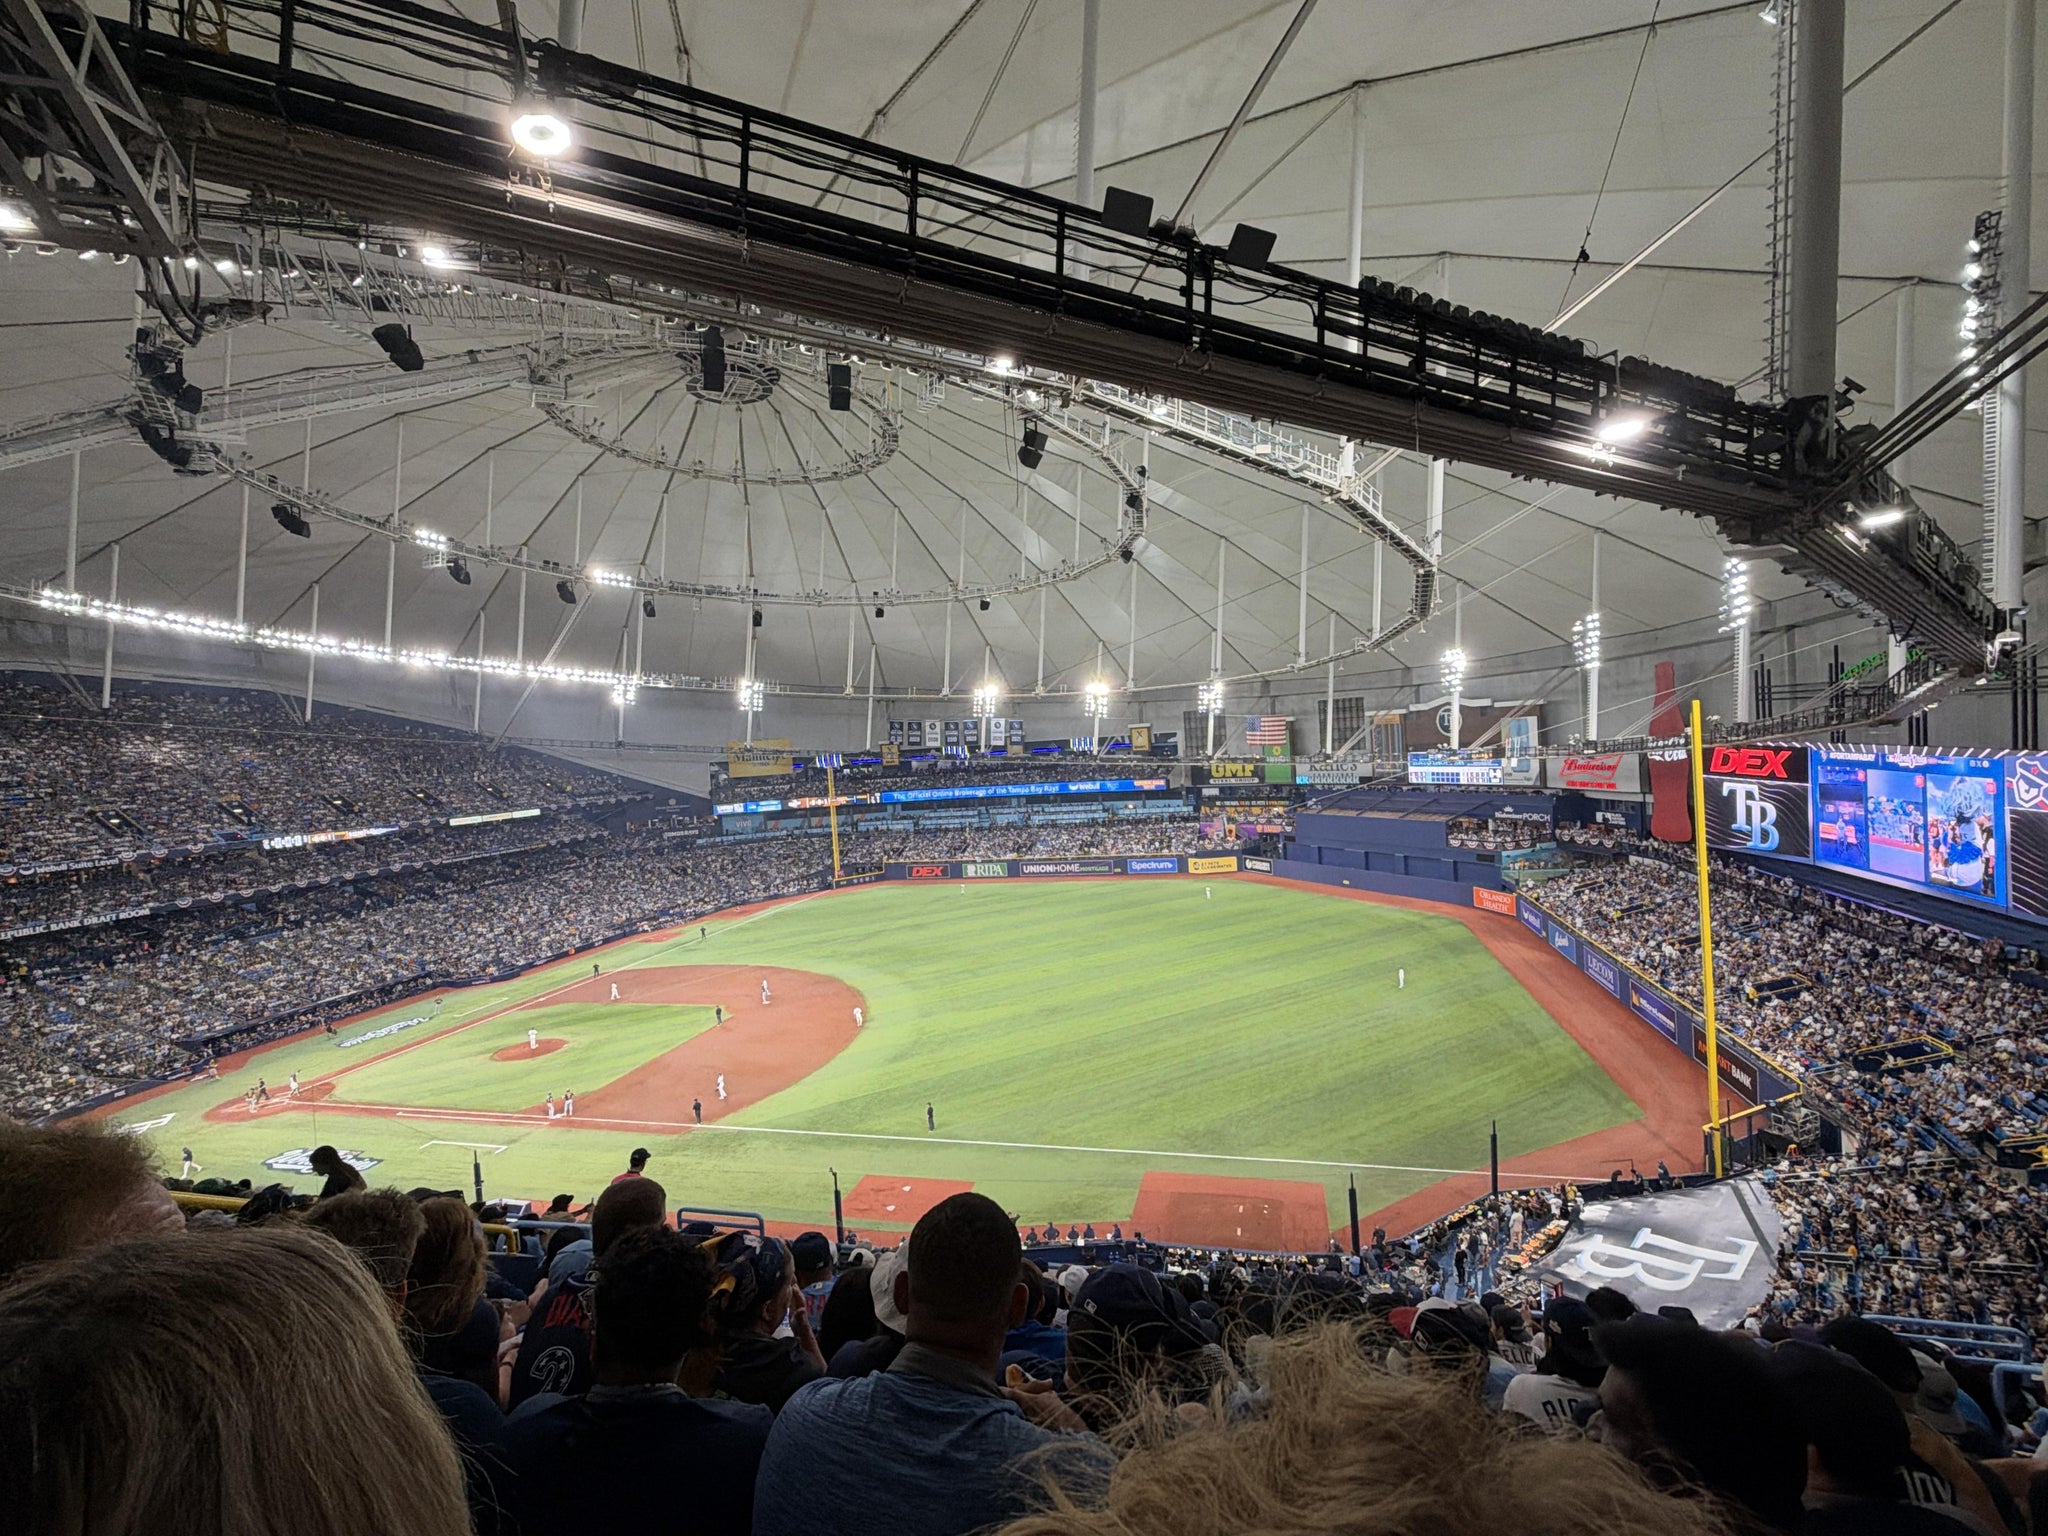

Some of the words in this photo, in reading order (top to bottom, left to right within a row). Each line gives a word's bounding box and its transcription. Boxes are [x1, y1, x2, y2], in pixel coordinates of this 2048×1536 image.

[1566, 759, 1617, 771] Budweiser
[1709, 746, 1792, 778] DEX
[908, 791, 931, 799] Official
[932, 790, 953, 798] Online
[954, 788, 987, 797] Brokerage
[1008, 786, 1030, 795] Tampa
[1030, 785, 1043, 795] Bay
[1044, 784, 1059, 794] Rays
[1523, 813, 1550, 822] PORCH
[36, 864, 67, 873] Webull
[69, 860, 94, 870] Suite
[95, 857, 119, 867] Level
[912, 866, 942, 876] DEX
[976, 864, 1002, 877] RIPA
[1131, 861, 1168, 870] Spectrum
[1479, 890, 1511, 904] ORLANDO
[1483, 901, 1508, 913] HEALTH
[50, 919, 81, 931] BANK
[83, 913, 117, 926] DRAFT
[119, 908, 151, 920] ROOM
[1731, 1064, 1752, 1090] BANK
